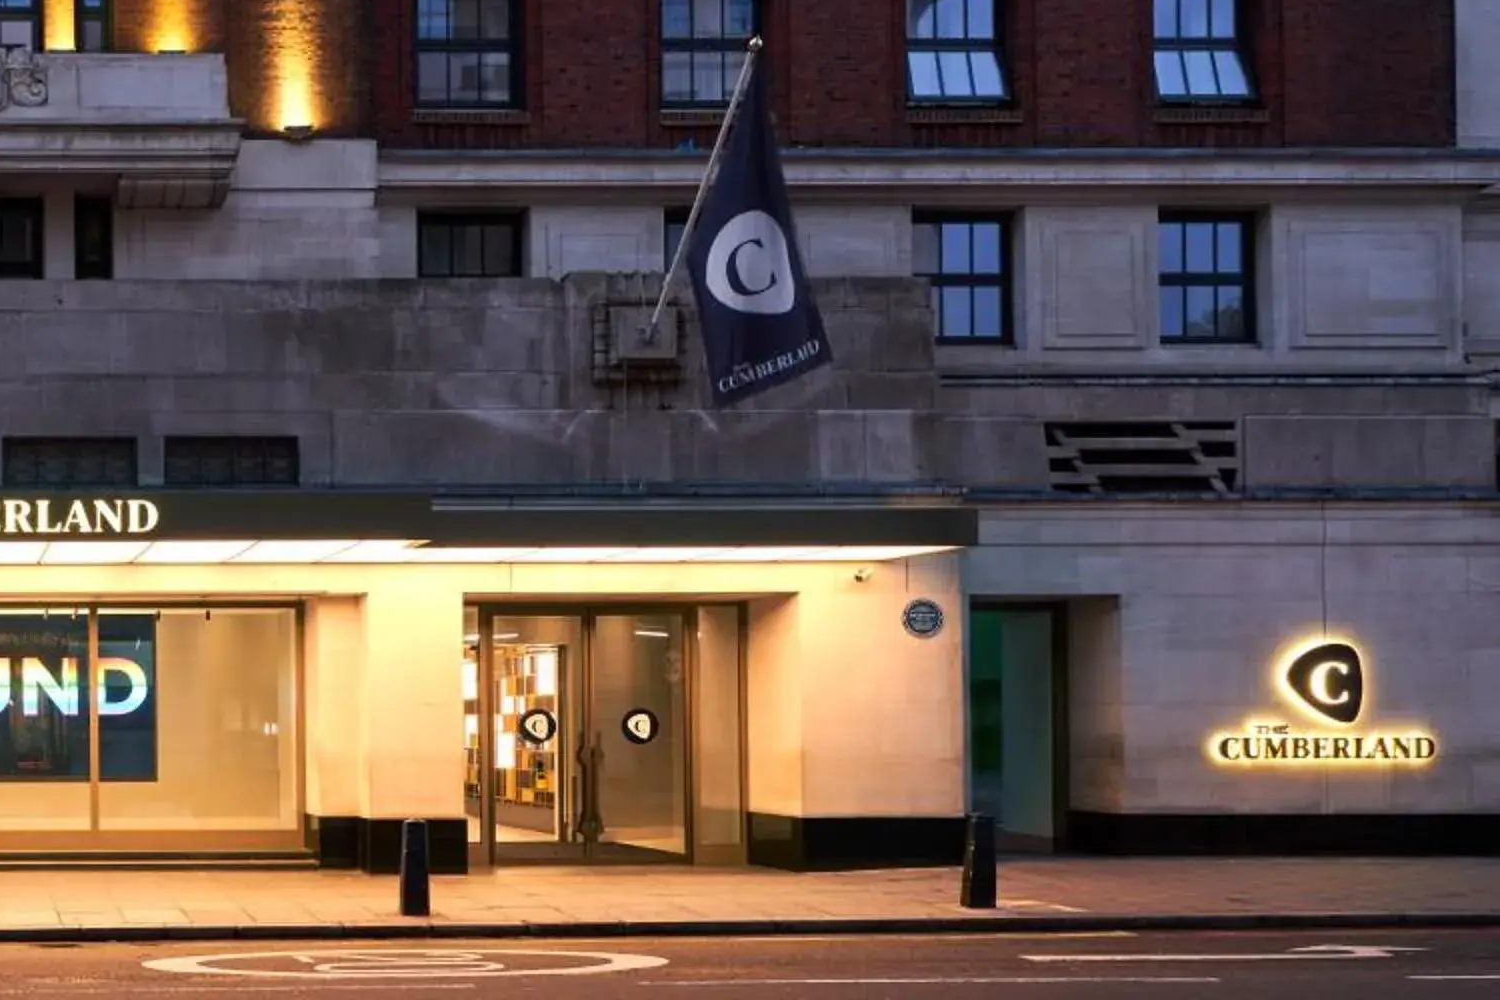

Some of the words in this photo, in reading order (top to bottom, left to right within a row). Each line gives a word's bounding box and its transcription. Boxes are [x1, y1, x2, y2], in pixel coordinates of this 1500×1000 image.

[726, 238, 777, 297] C
[1310, 661, 1349, 705] C
[1218, 737, 1436, 760] CUMBERLAND
